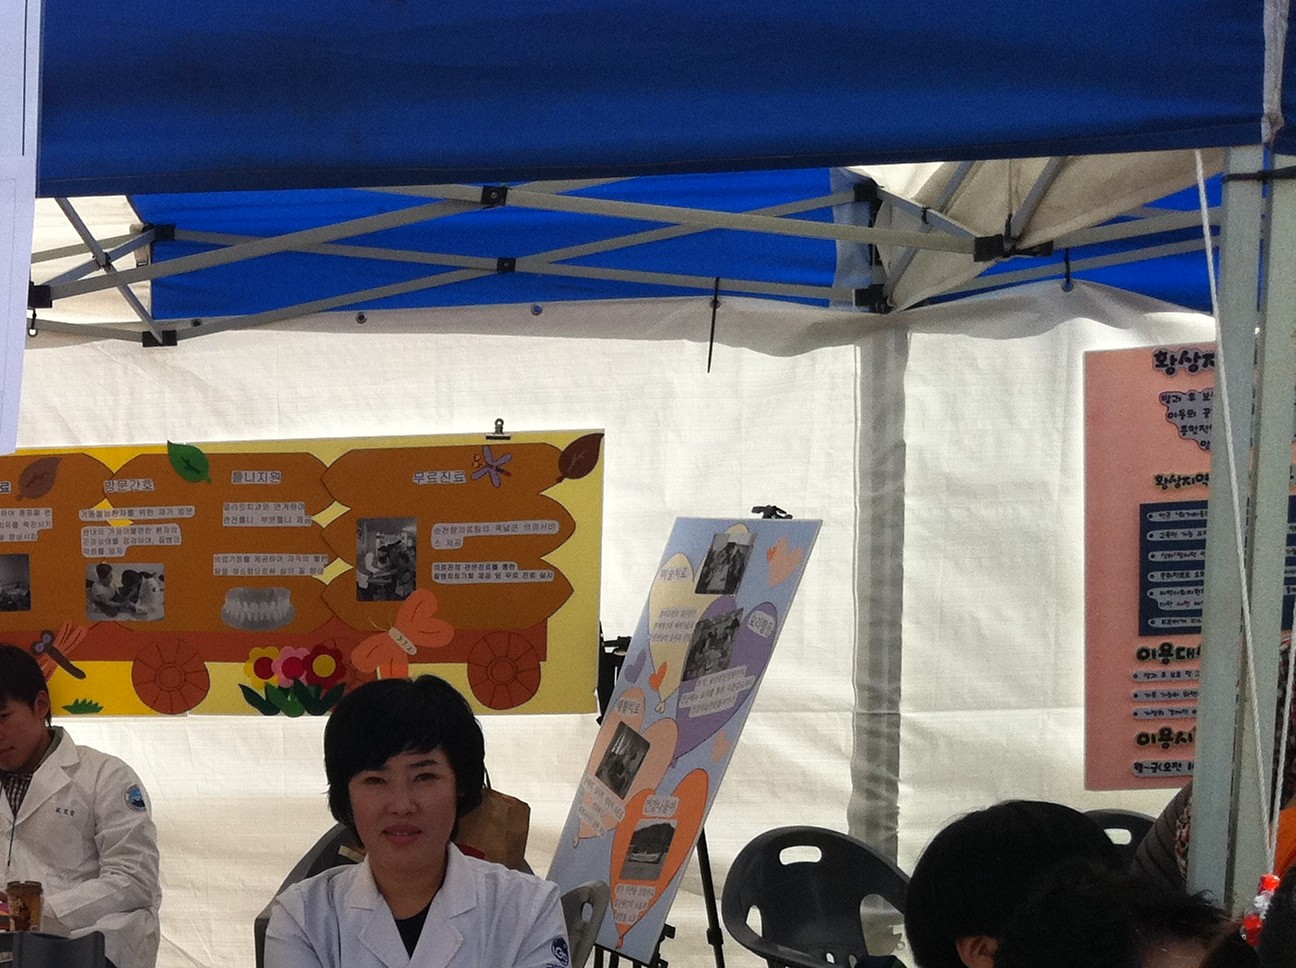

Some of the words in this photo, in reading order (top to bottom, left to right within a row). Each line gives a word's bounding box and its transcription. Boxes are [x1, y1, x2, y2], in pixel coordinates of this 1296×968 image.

[232, 472, 280, 483] 틀니지원
[414, 471, 465, 483] 무료진료
[105, 479, 152, 492] 방문간호
[1136, 642, 1201, 664] 이용대
[1136, 726, 1196, 749] 이용시
